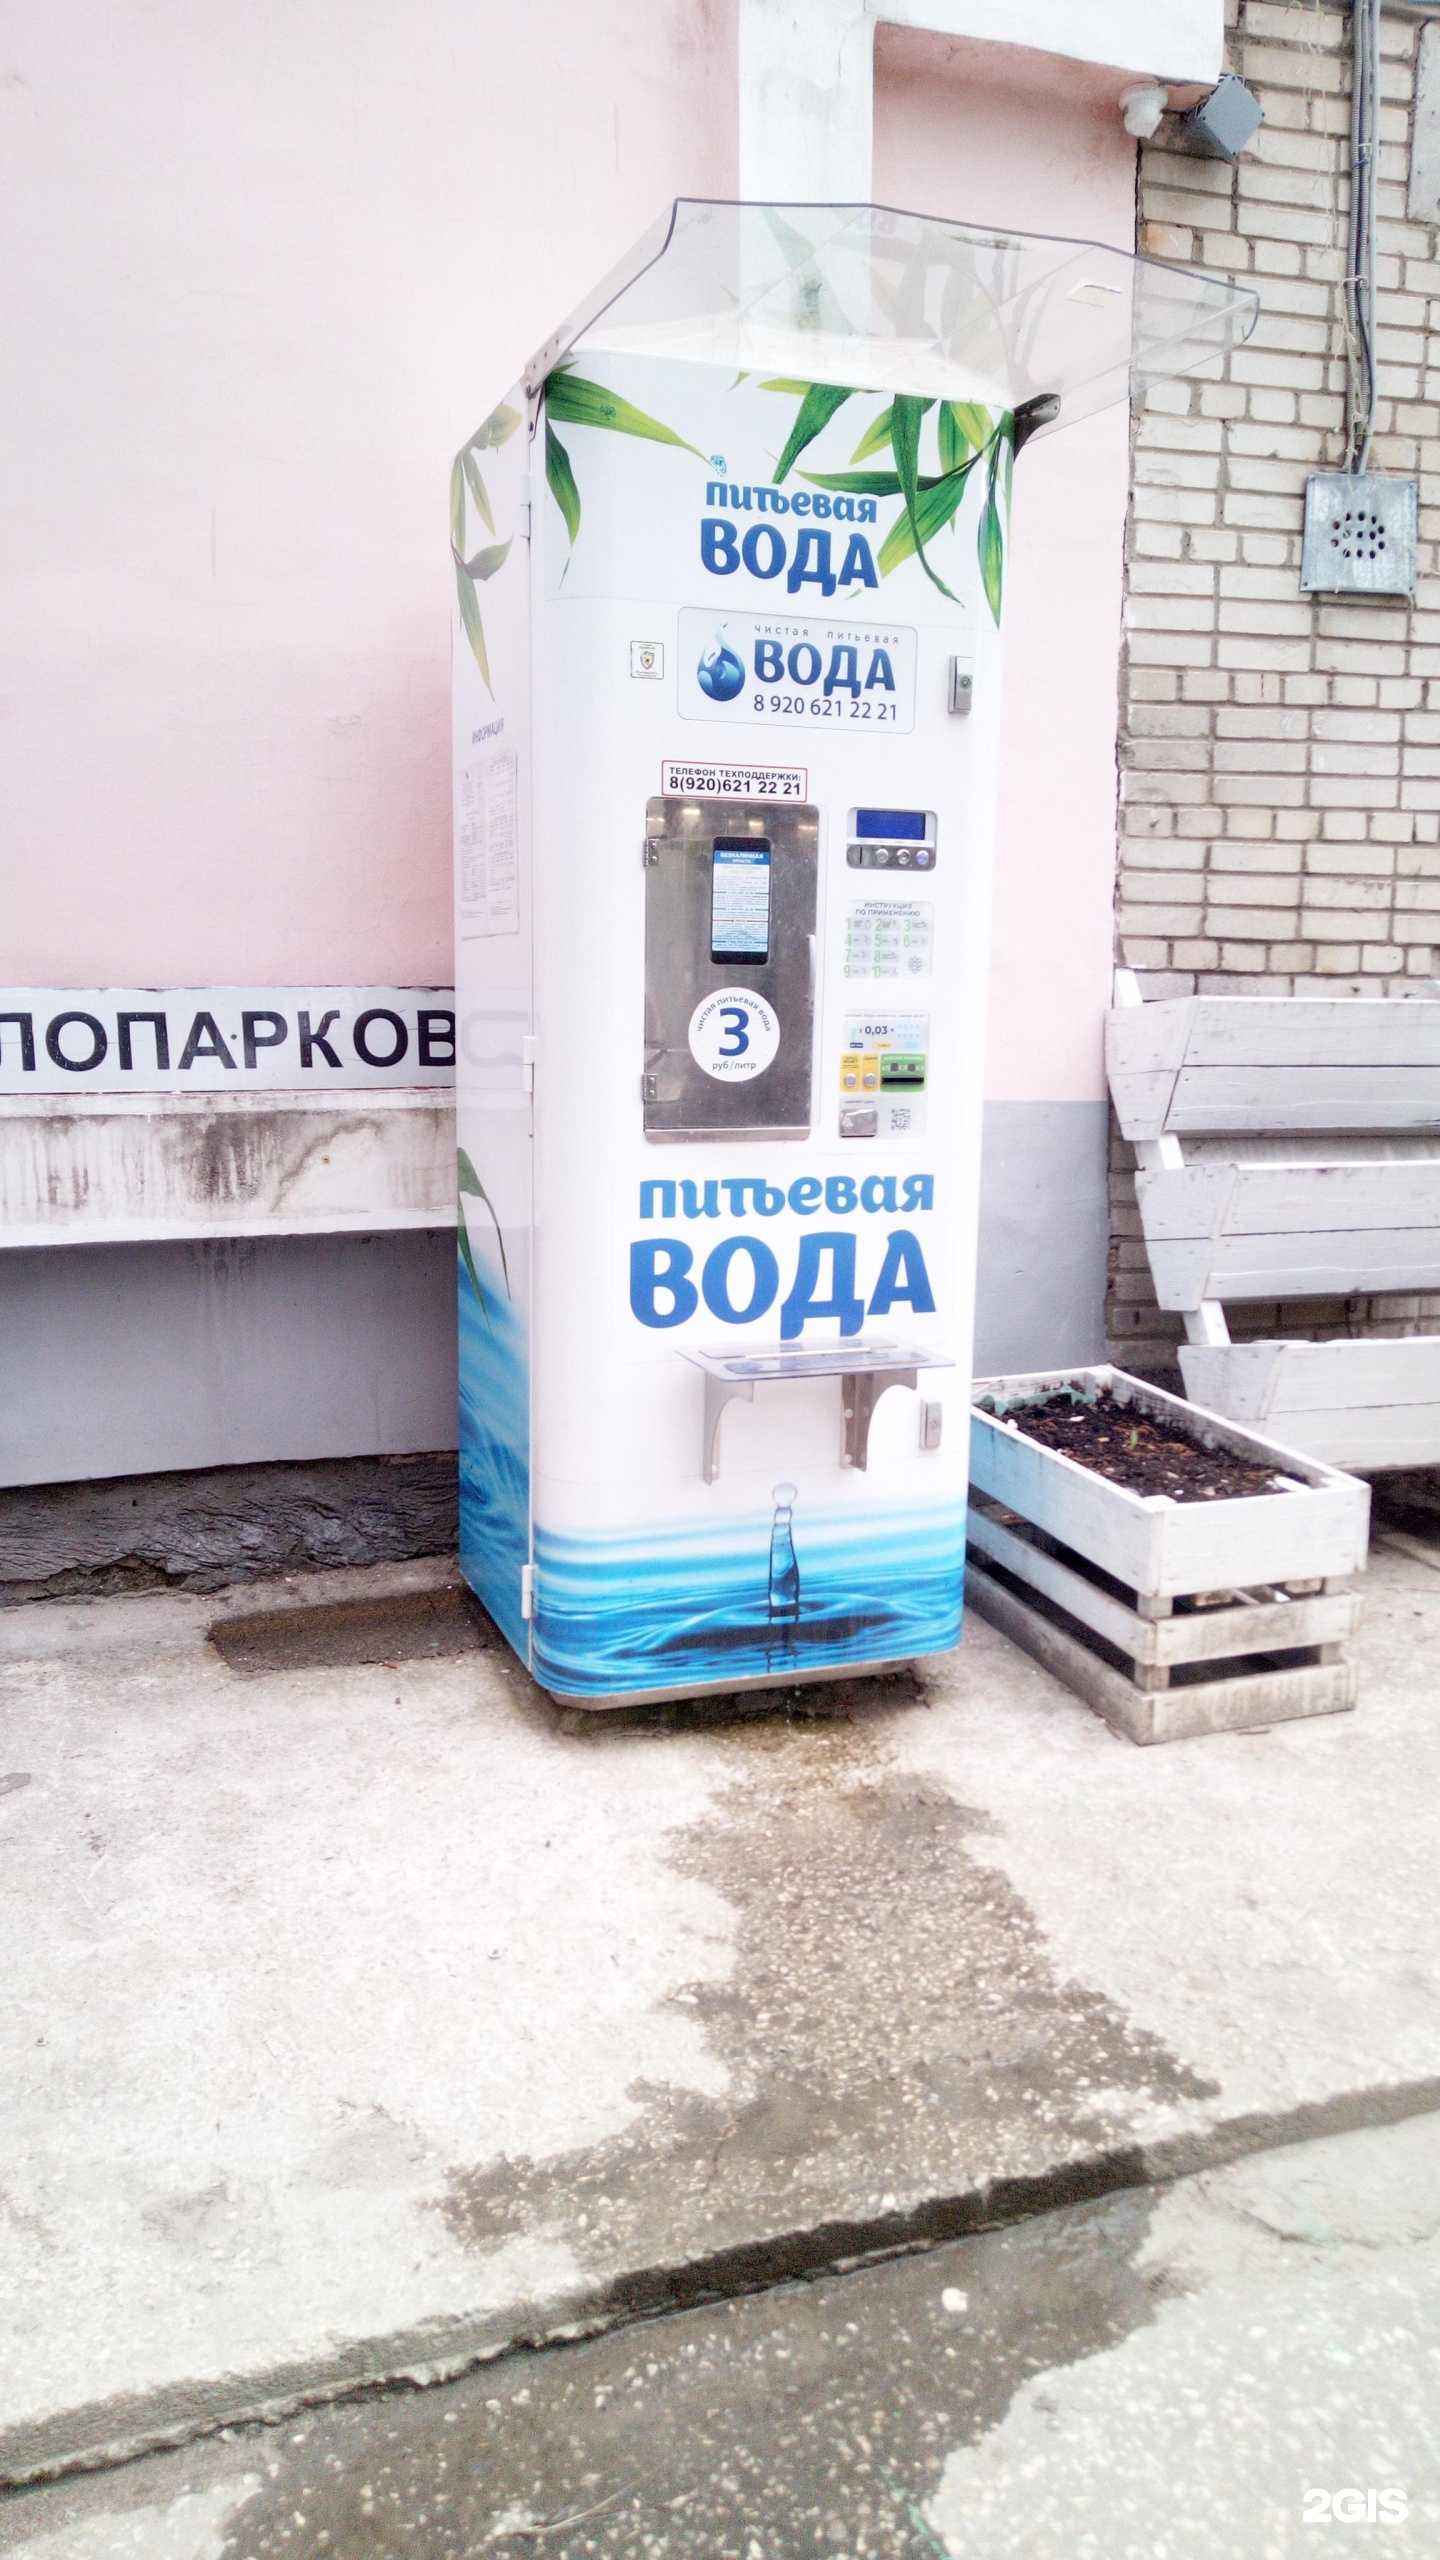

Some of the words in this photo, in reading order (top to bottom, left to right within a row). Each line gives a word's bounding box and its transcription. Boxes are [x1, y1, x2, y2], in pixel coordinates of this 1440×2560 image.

[706, 481, 878, 523] питьевая
[700, 518, 879, 597] ВОДА
[754, 624, 809, 637] чистая
[827, 630, 899, 644] питьевая
[754, 639, 896, 699] ВОДА
[754, 694, 764, 711] 8
[770, 695, 805, 714] 920
[810, 698, 842, 716] 621
[850, 701, 871, 719] 22
[877, 703, 897, 721] 21
[669, 767, 716, 777] ТЕЛЕФОН
[669, 776, 751, 794] 8(920)621
[758, 781, 777, 795] 22
[783, 782, 800, 796] 21
[719, 1007, 749, 1057] 3
[639, 1174, 935, 1219] питьевая
[629, 1229, 937, 1341] ВОДА
